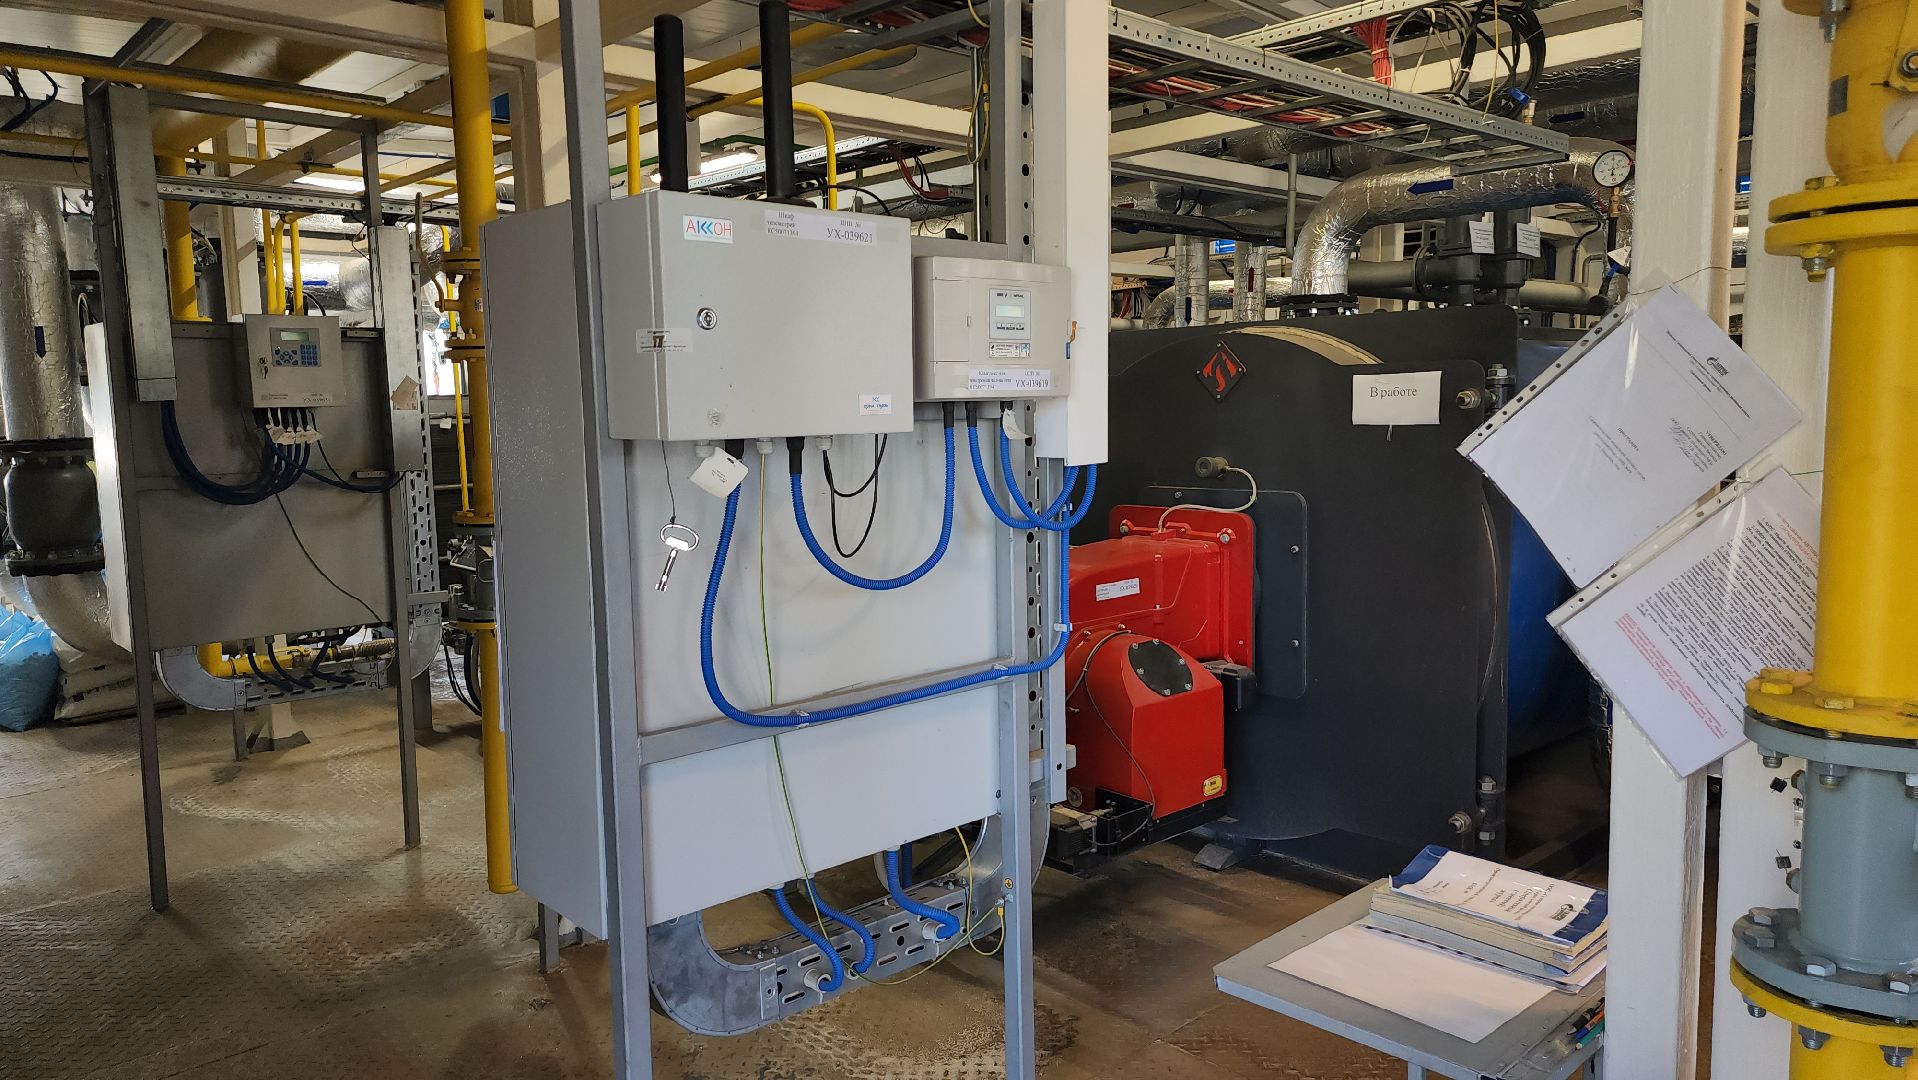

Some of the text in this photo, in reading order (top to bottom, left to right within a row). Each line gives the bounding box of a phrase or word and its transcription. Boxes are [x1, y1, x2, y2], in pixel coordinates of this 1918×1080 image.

[778, 211, 795, 221] Шкаф
[1370, 386, 1418, 399] В работе
